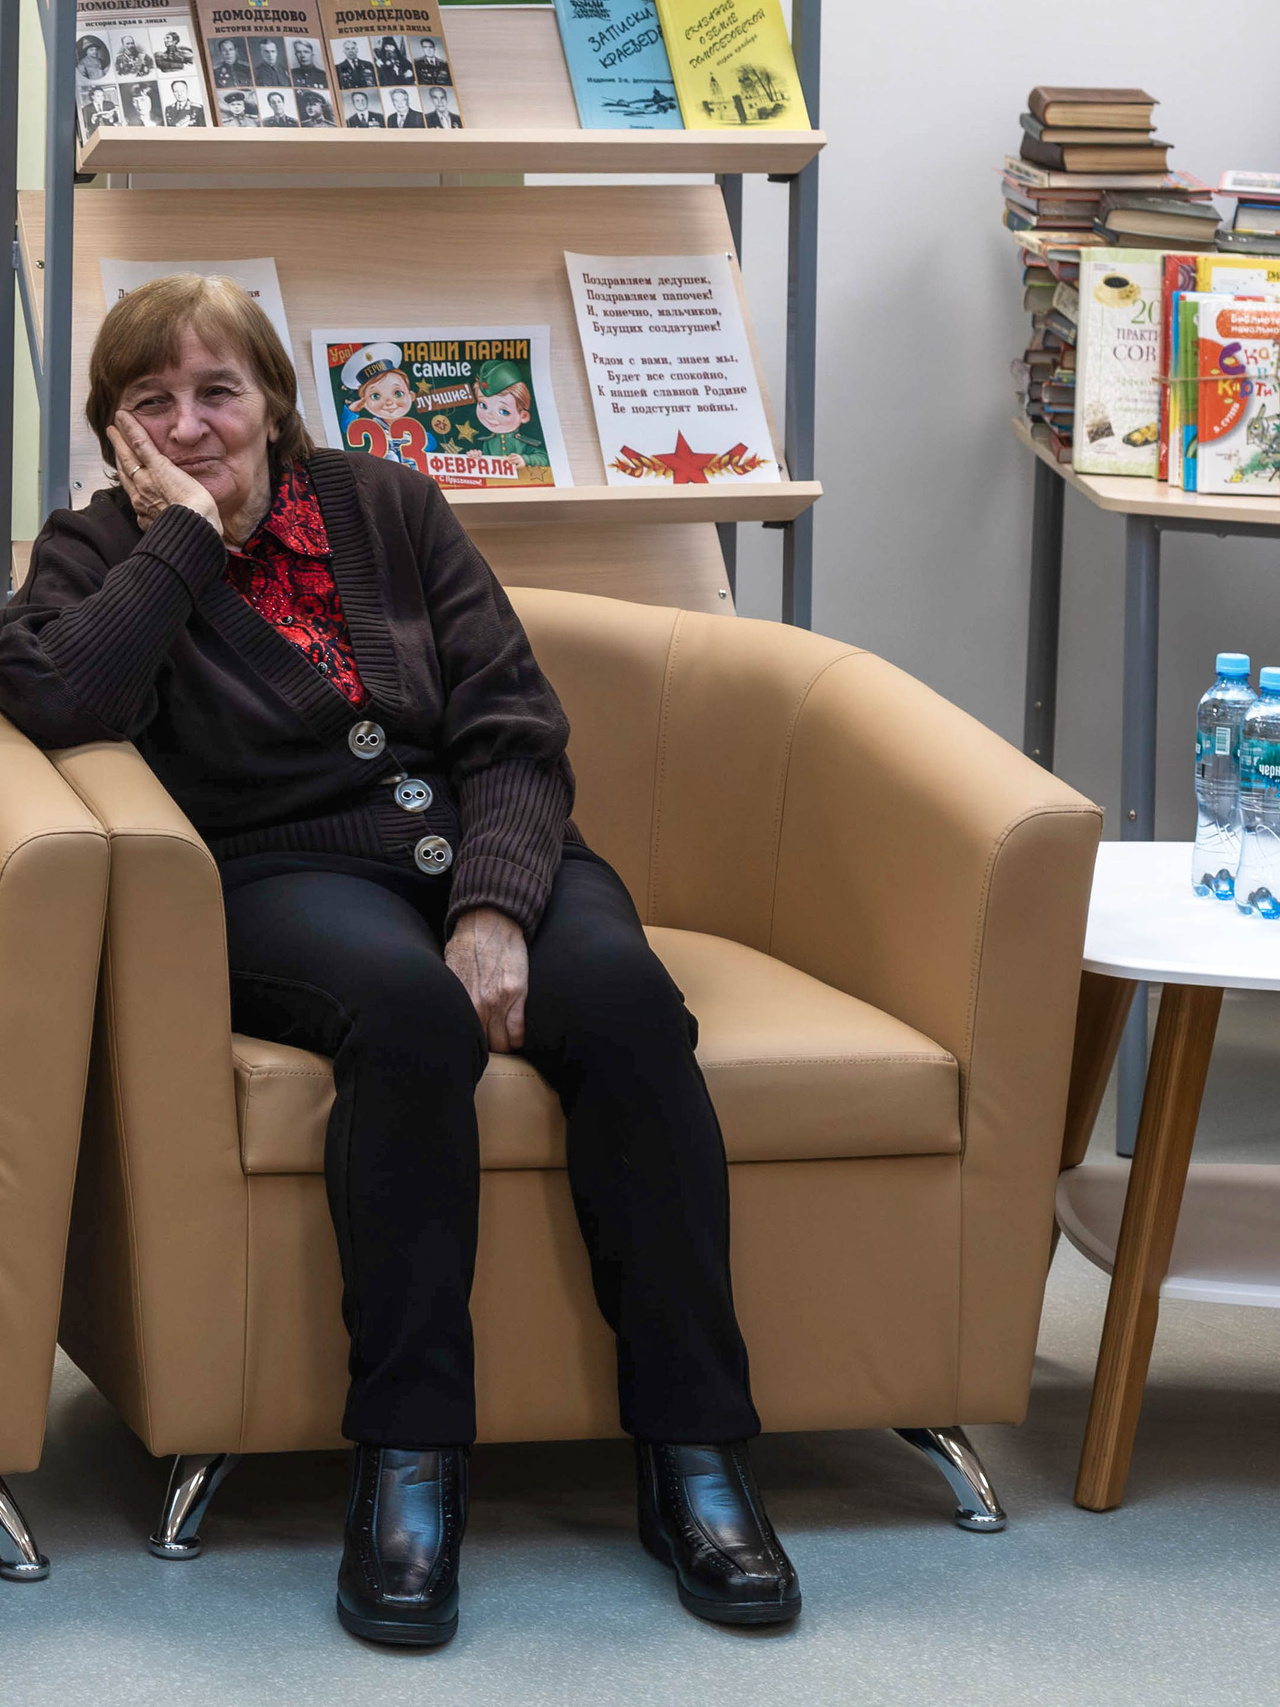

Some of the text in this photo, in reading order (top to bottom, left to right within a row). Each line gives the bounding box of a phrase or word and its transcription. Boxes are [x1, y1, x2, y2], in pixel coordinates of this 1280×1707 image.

[77, 0, 169, 12] ДОМОДЕДОВО
[212, 10, 307, 23] ДОМОДЕДОВО
[335, 9, 430, 24] ДОМОДЕДОВО
[685, 0, 735, 40] СКАЗАНИЕ
[338, 25, 375, 34] ИСТОРИЯ
[588, 7, 654, 52] ЗАПИСКИ
[699, 12, 738, 45] О ЗЕМЛЕ
[689, 8, 766, 69] ДОМОДЕДОВСКОЙ
[582, 273, 711, 288] Поздравляем дедушек,
[586, 289, 713, 304] Поздравляем папочек!
[586, 305, 722, 318] И, конечно, мальчиков,
[592, 320, 721, 336] Будущих солдатушек!
[329, 344, 354, 363] Ура!
[403, 340, 528, 362] НАШИ ПАРНИ
[592, 353, 623, 366] Рядом
[641, 356, 672, 365] вами,
[677, 355, 710, 364] знаем
[716, 354, 738, 364] мы,
[413, 362, 472, 378] самые
[607, 370, 728, 384] Будет все спокойно,
[416, 383, 473, 411] лучшие!
[597, 384, 747, 398] К нашей славной Родине
[612, 403, 738, 416] Не подступят войны.
[347, 417, 428, 476] 23
[430, 456, 514, 476] ФЕВРАЛЯ
